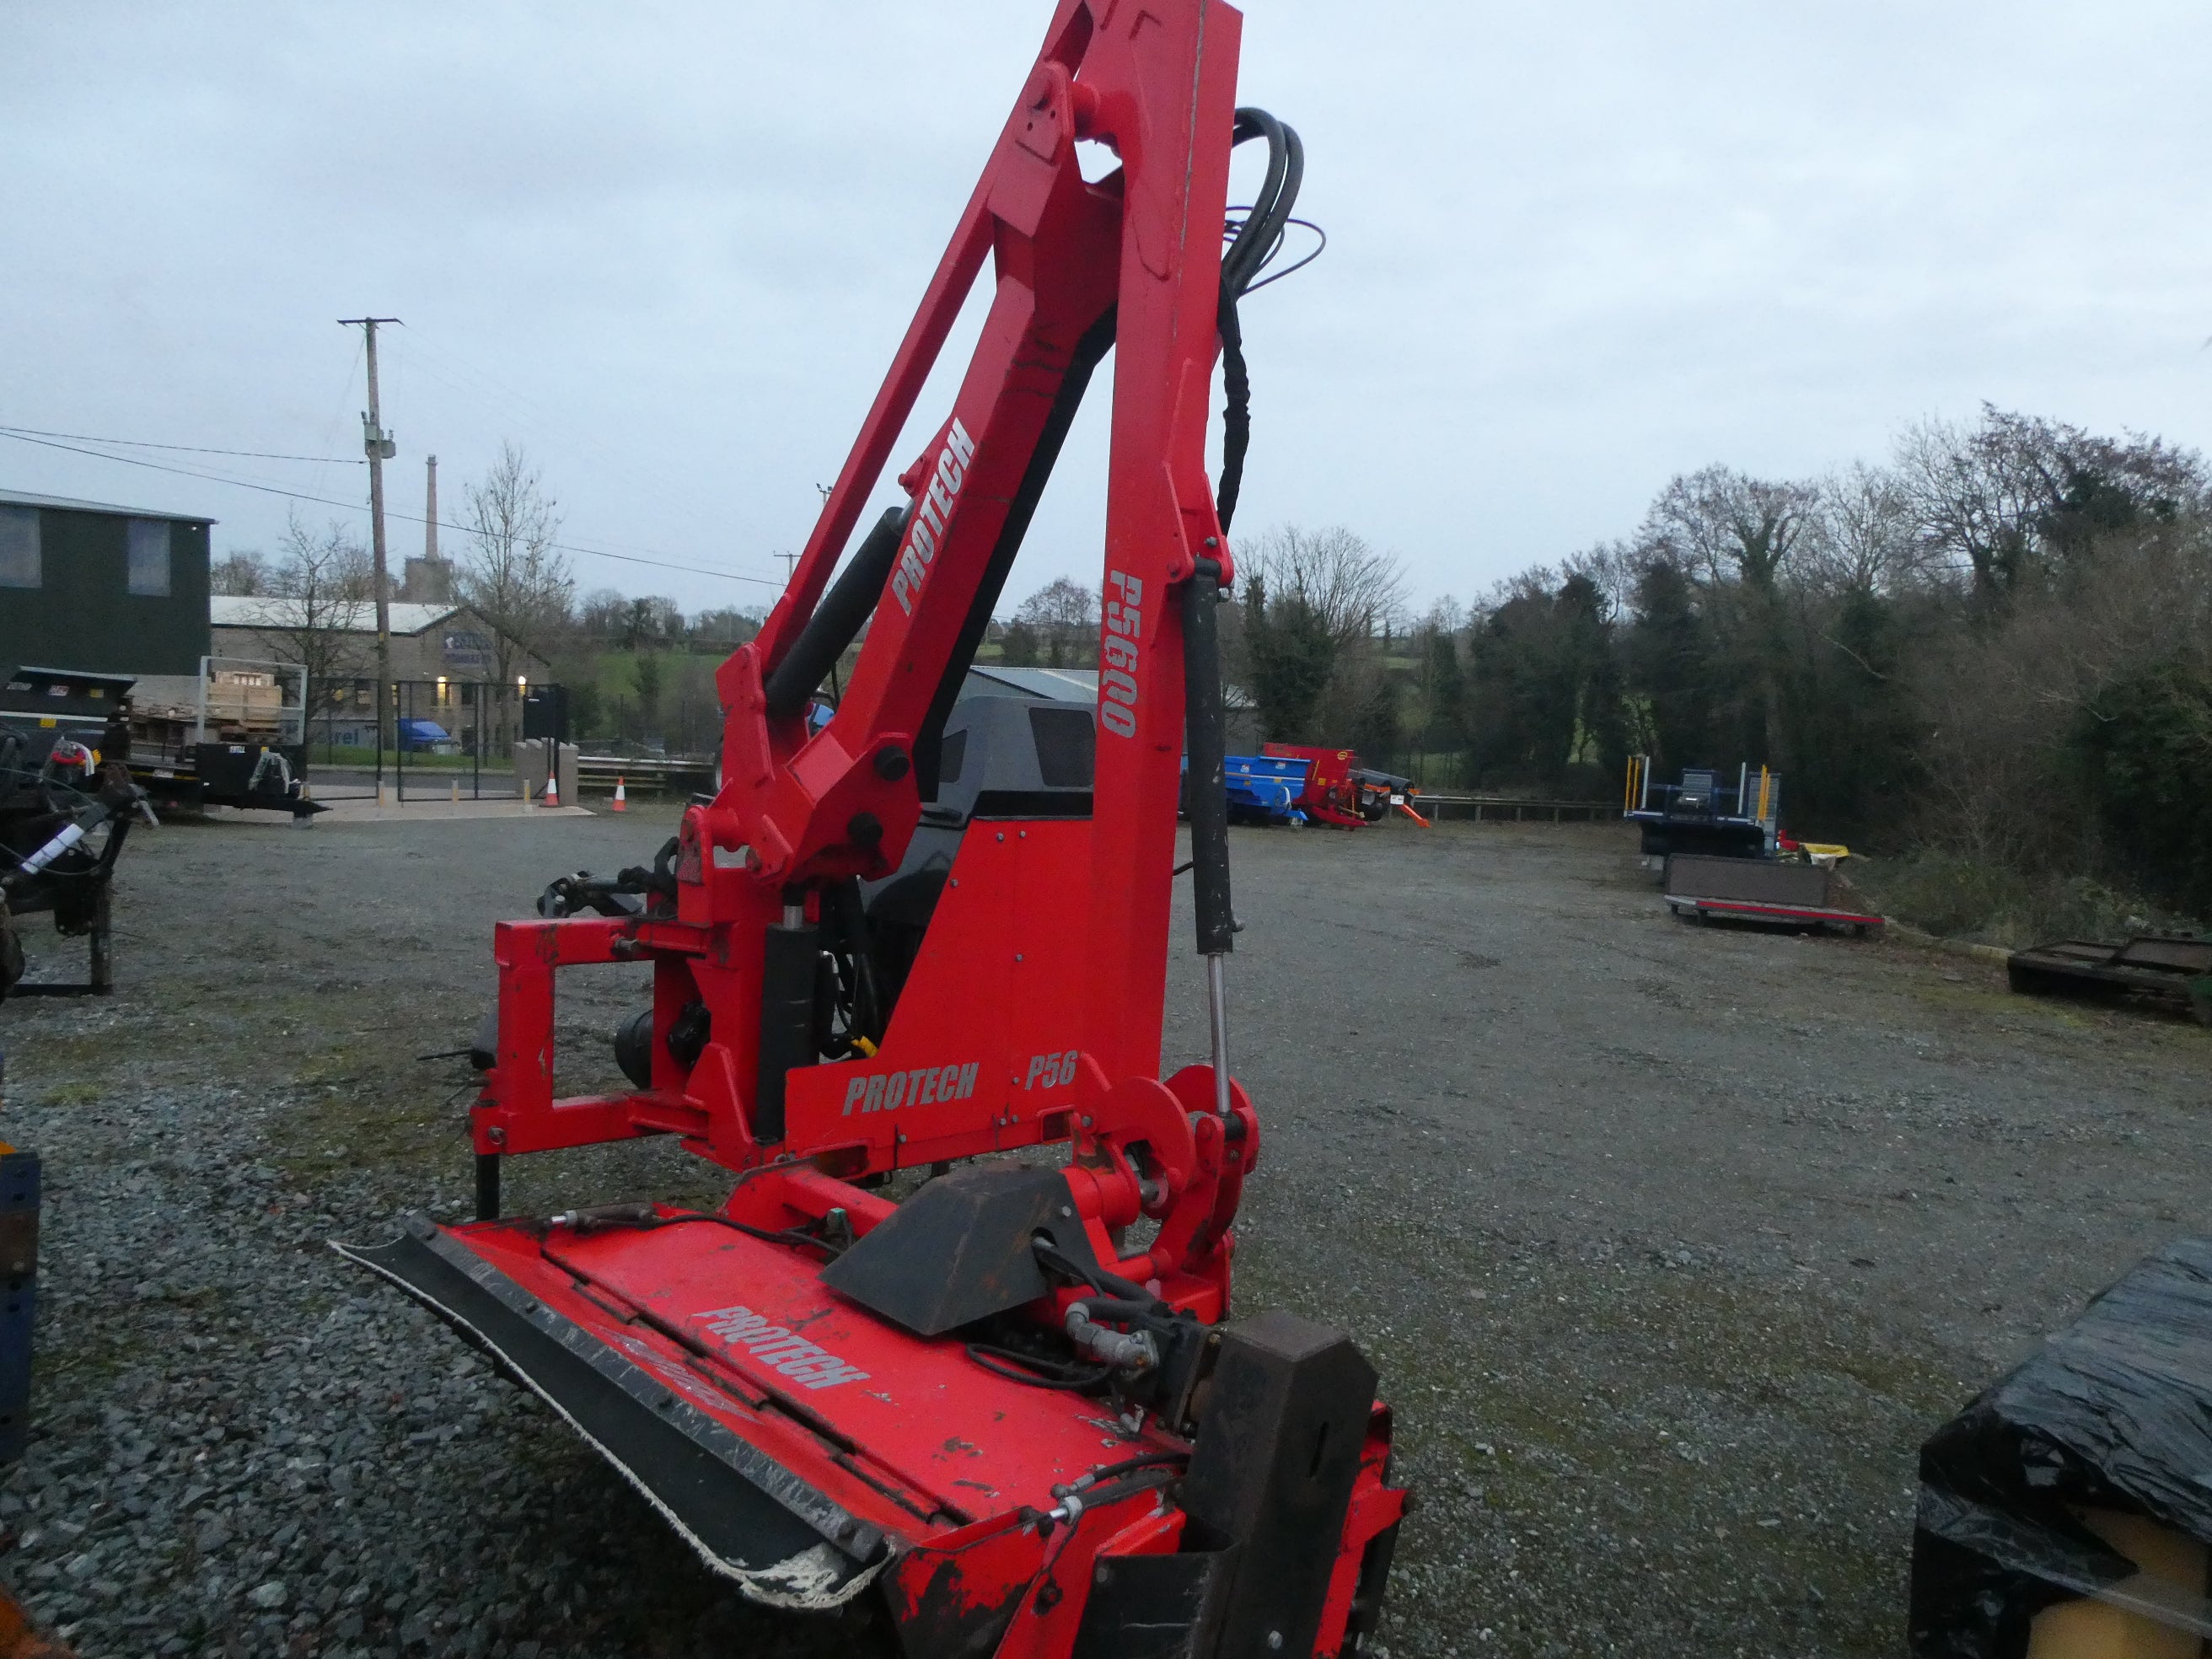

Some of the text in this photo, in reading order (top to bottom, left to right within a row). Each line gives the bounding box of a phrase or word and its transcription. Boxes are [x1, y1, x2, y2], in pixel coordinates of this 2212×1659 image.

[892, 417, 974, 617] PROTECH
[1101, 569, 1143, 738] P5600
[841, 1050, 1078, 1116] PROTECH P56
[691, 1305, 871, 1389] PROTECH
